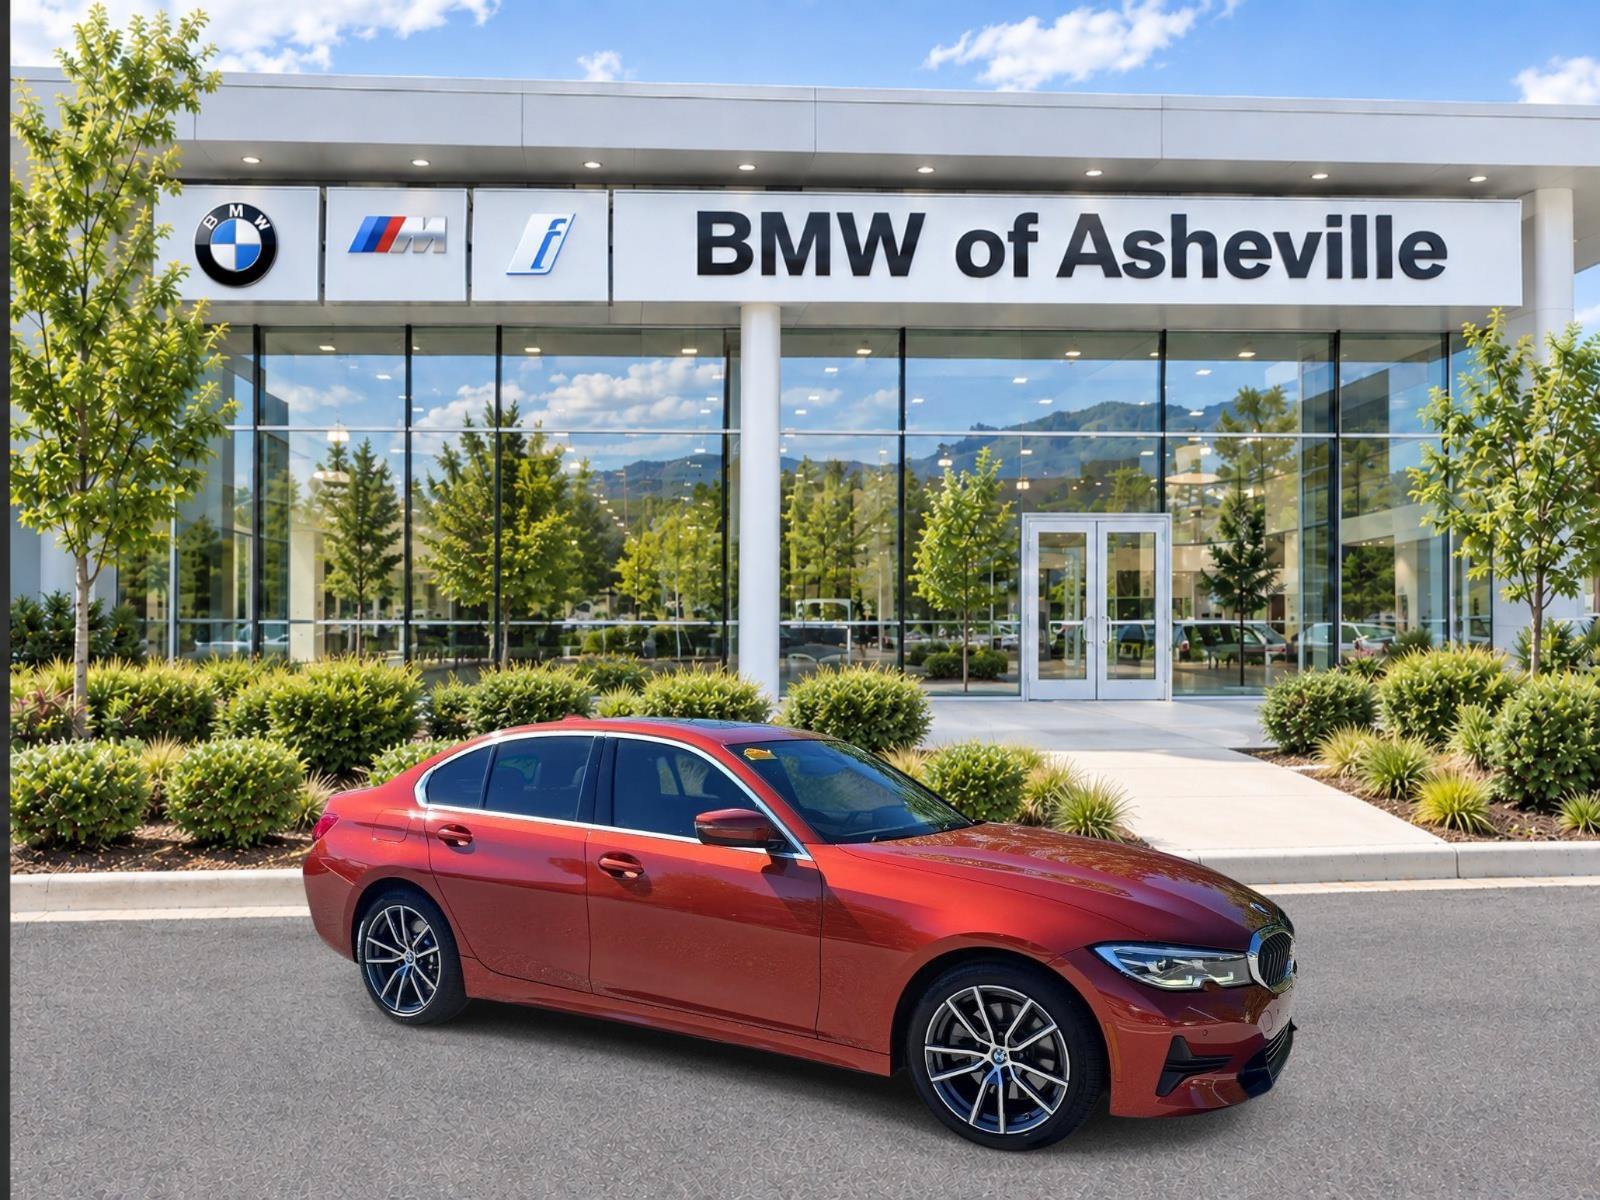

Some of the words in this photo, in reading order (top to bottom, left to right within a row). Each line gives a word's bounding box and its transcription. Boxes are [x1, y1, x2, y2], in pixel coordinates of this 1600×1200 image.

[202, 203, 271, 231] BMW
[696, 210, 927, 277] BMW
[955, 212, 1039, 279] of
[1056, 213, 1449, 281] Asheville
